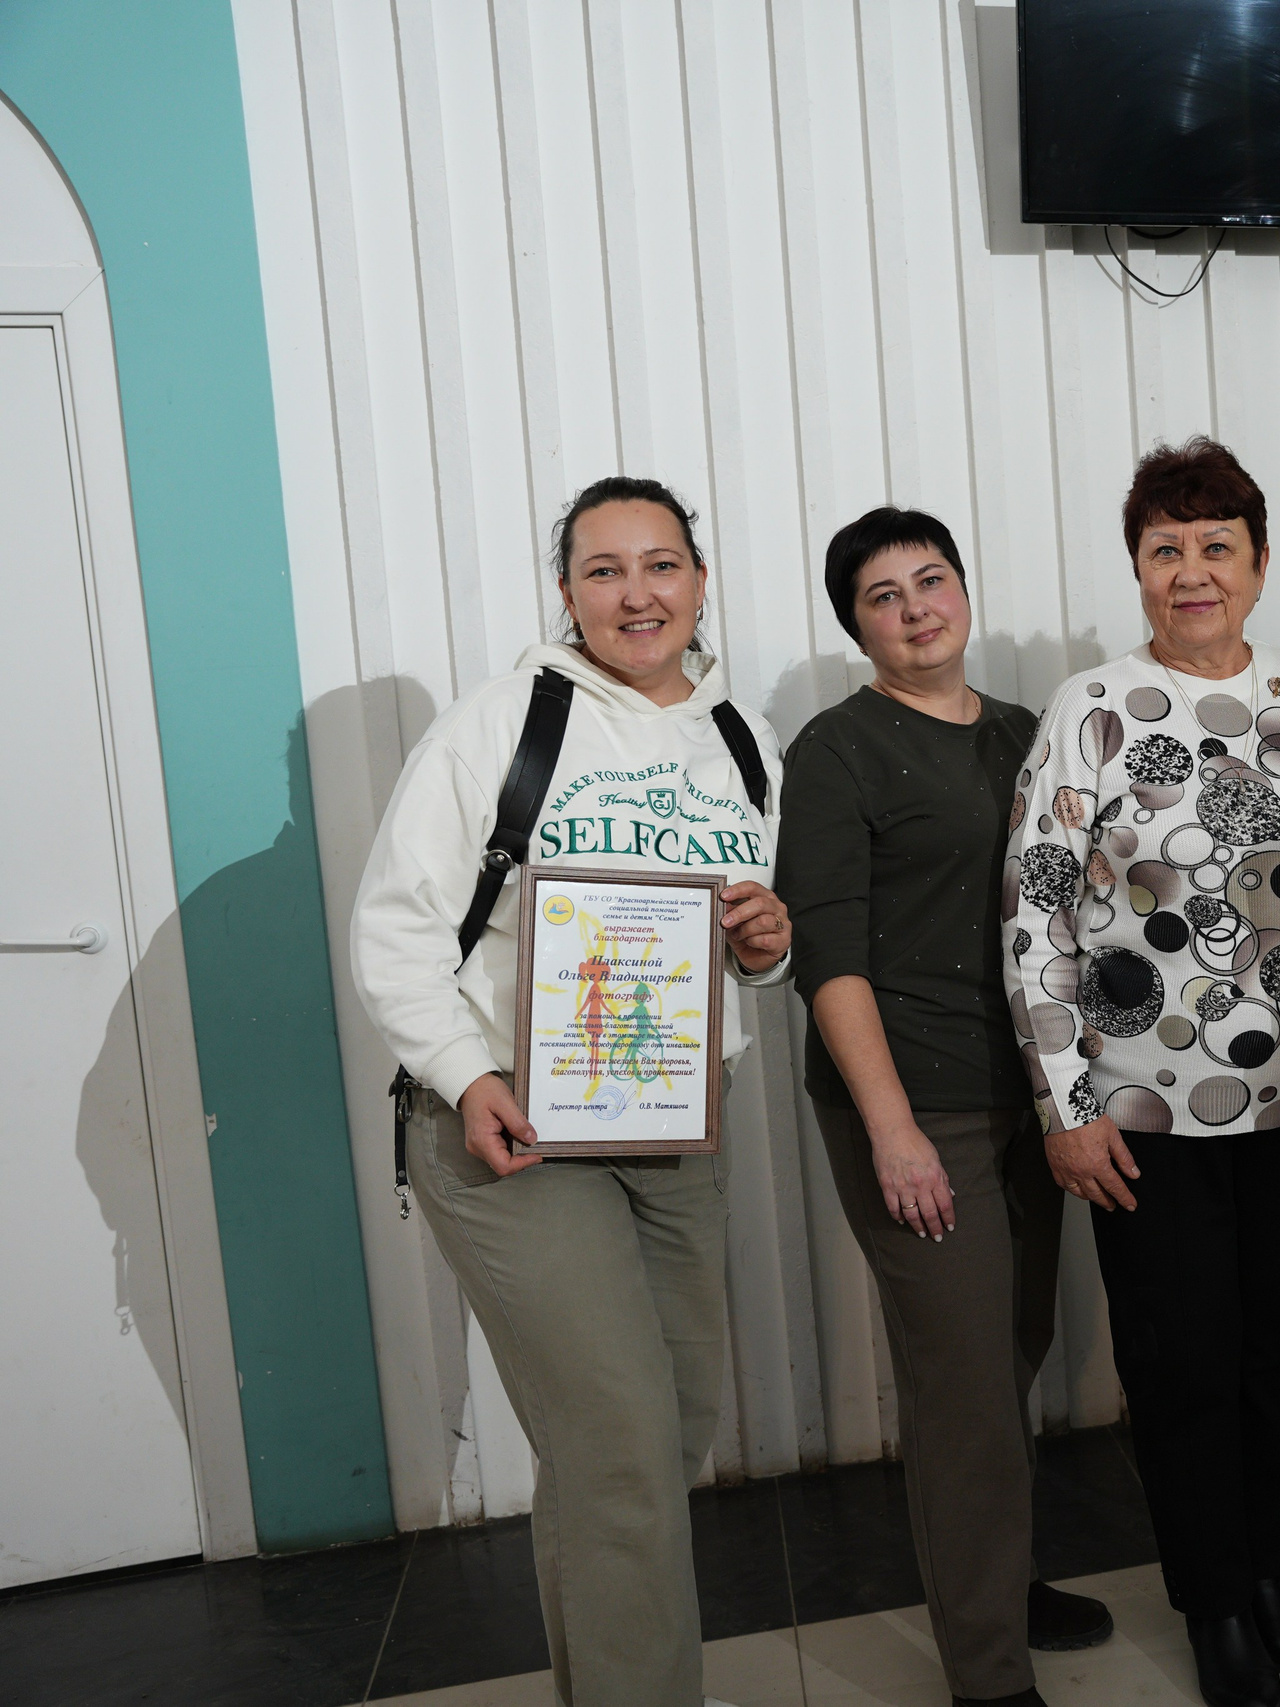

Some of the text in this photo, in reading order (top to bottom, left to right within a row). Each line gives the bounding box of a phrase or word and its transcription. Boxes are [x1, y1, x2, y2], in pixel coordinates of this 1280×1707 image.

[550, 774, 595, 813] MAKE
[594, 762, 679, 782] YOURSELF
[684, 779, 748, 822] PRIORITY
[598, 792, 648, 809] Healthy
[653, 799, 671, 811] GJ
[540, 817, 768, 867] SELFCARE
[614, 896, 678, 906] "Красноармейский
[608, 904, 648, 912] социальной
[603, 925, 654, 934] выражает
[593, 933, 663, 944] благодарность
[590, 954, 662, 967] Плаксиной
[558, 969, 692, 985] Ольге Владимировне
[588, 991, 654, 1002] фотографу
[586, 1057, 606, 1066] души
[657, 1058, 691, 1066] здоровья,
[550, 1067, 604, 1076] благополучия,
[605, 1068, 635, 1076] успехов
[643, 1068, 696, 1076] процветания!
